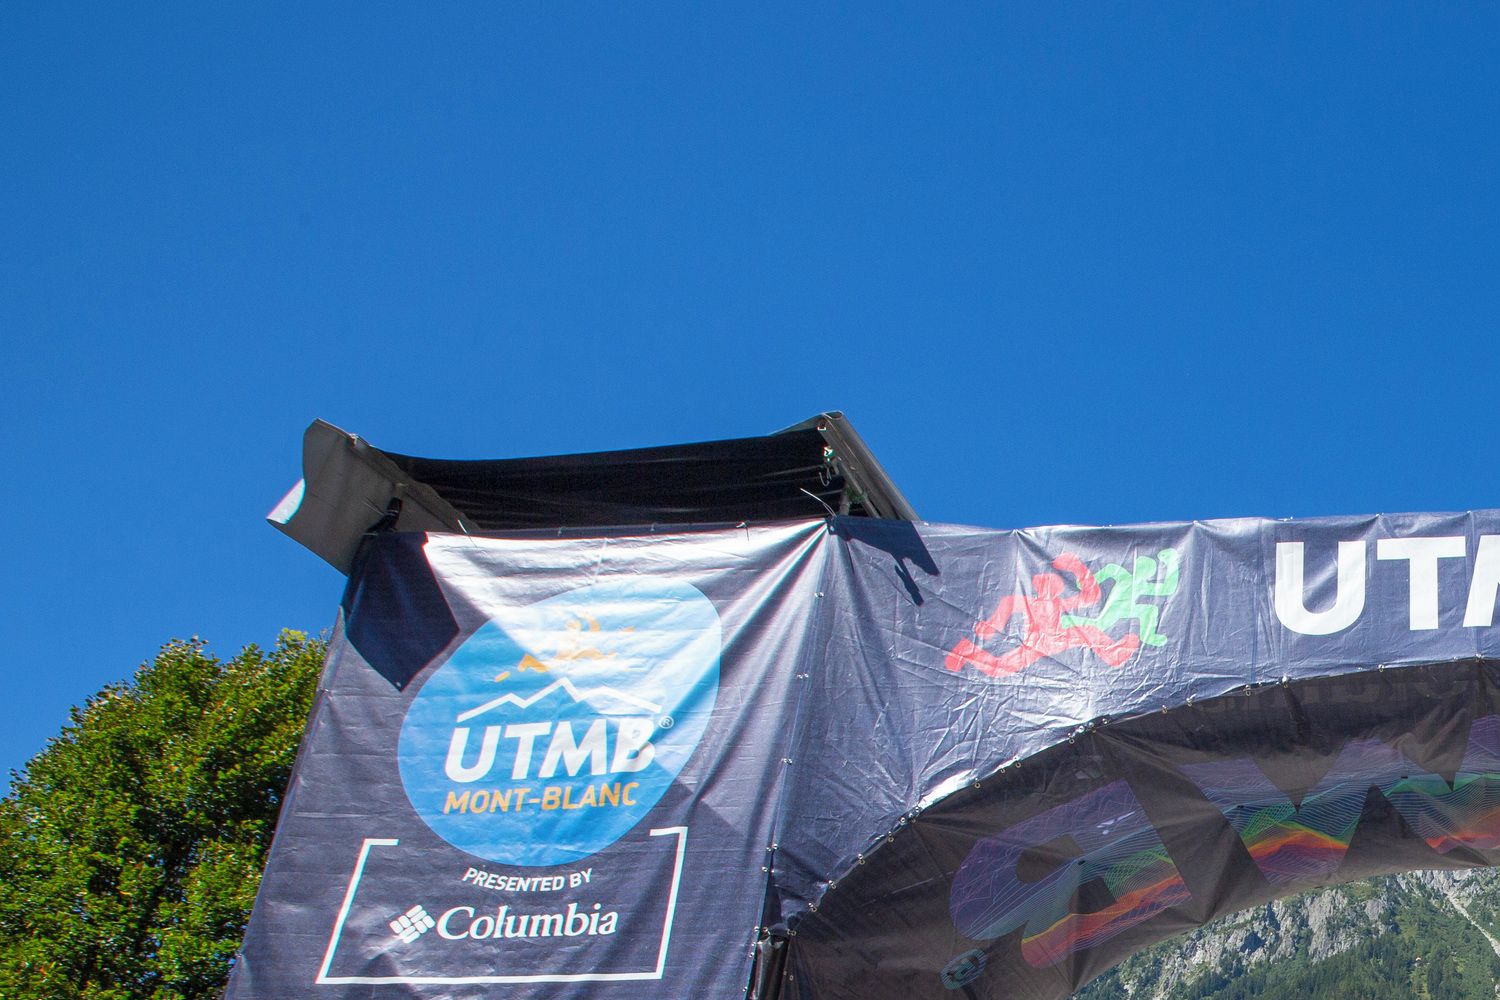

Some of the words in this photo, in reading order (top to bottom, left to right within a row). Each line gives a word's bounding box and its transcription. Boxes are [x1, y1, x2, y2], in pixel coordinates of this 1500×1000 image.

[443, 780, 640, 815] MONT-BLANC
[462, 867, 571, 892] PRESENTED
[570, 867, 593, 890] BY
[437, 903, 619, 941] Columbia
